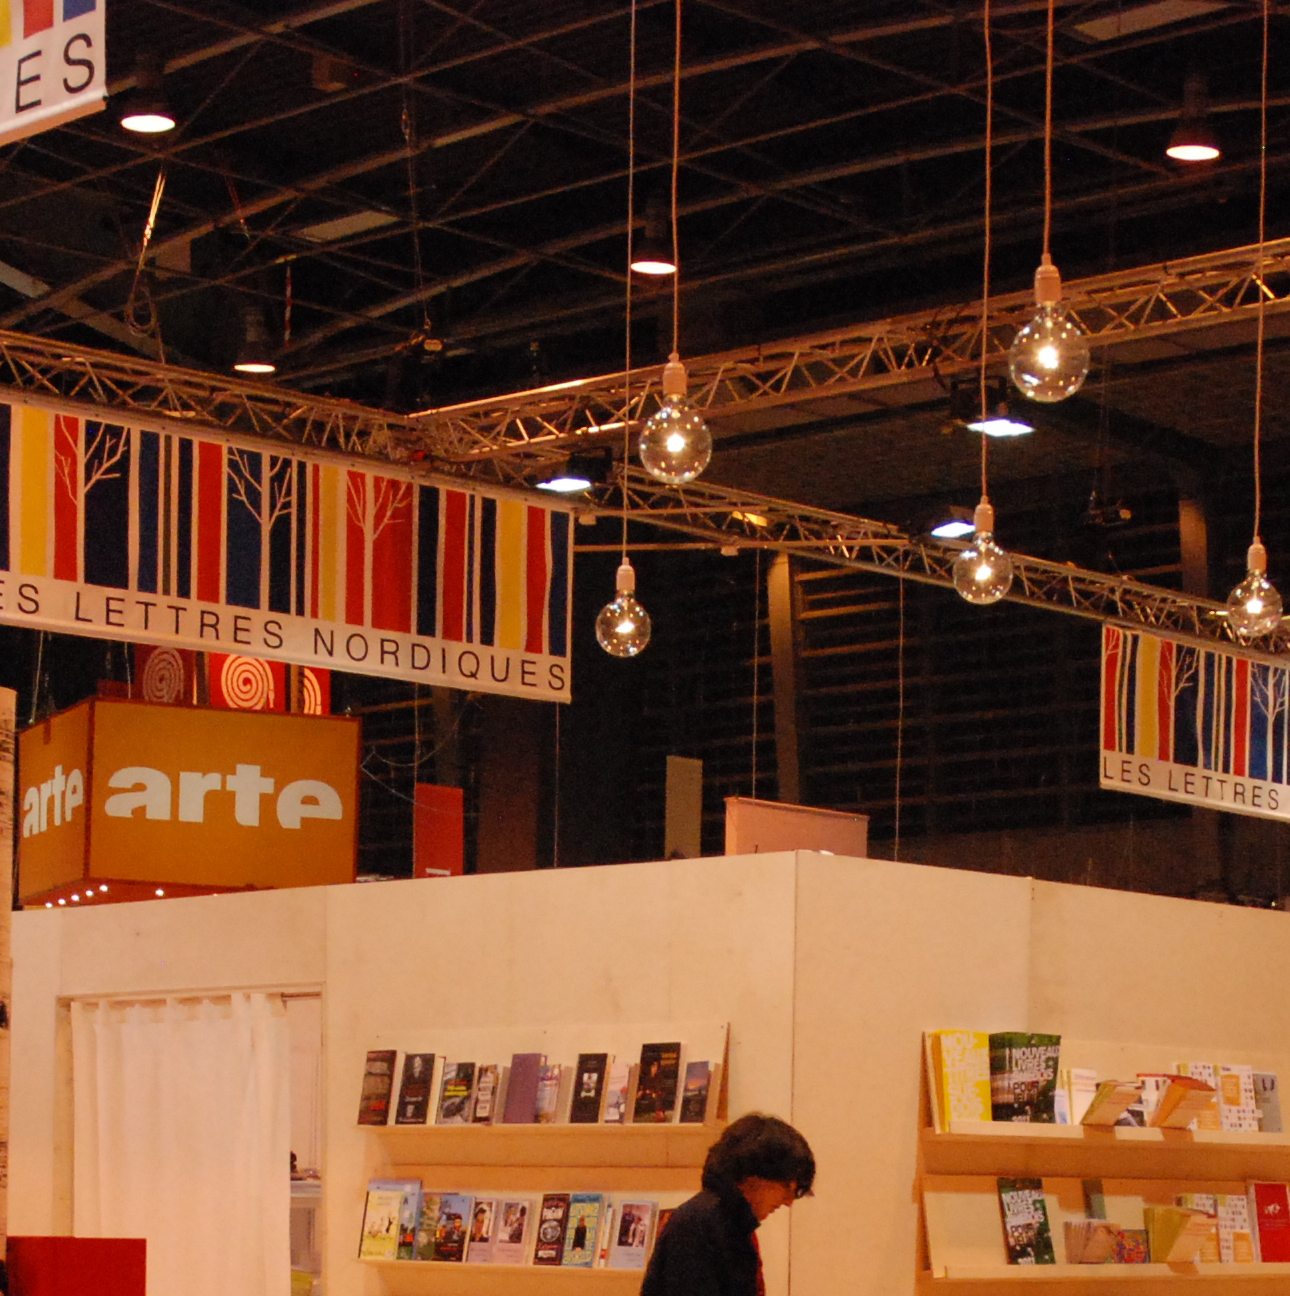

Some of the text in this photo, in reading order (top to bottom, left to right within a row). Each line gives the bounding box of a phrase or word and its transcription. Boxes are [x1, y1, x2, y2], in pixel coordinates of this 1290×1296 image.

[75, 590, 285, 650] LETTRES
[313, 629, 566, 692] NORDIQUES
[22, 763, 84, 839] arte
[103, 763, 344, 830] arte
[1103, 757, 1151, 786] LES
[1168, 769, 1279, 811] LETTRES
